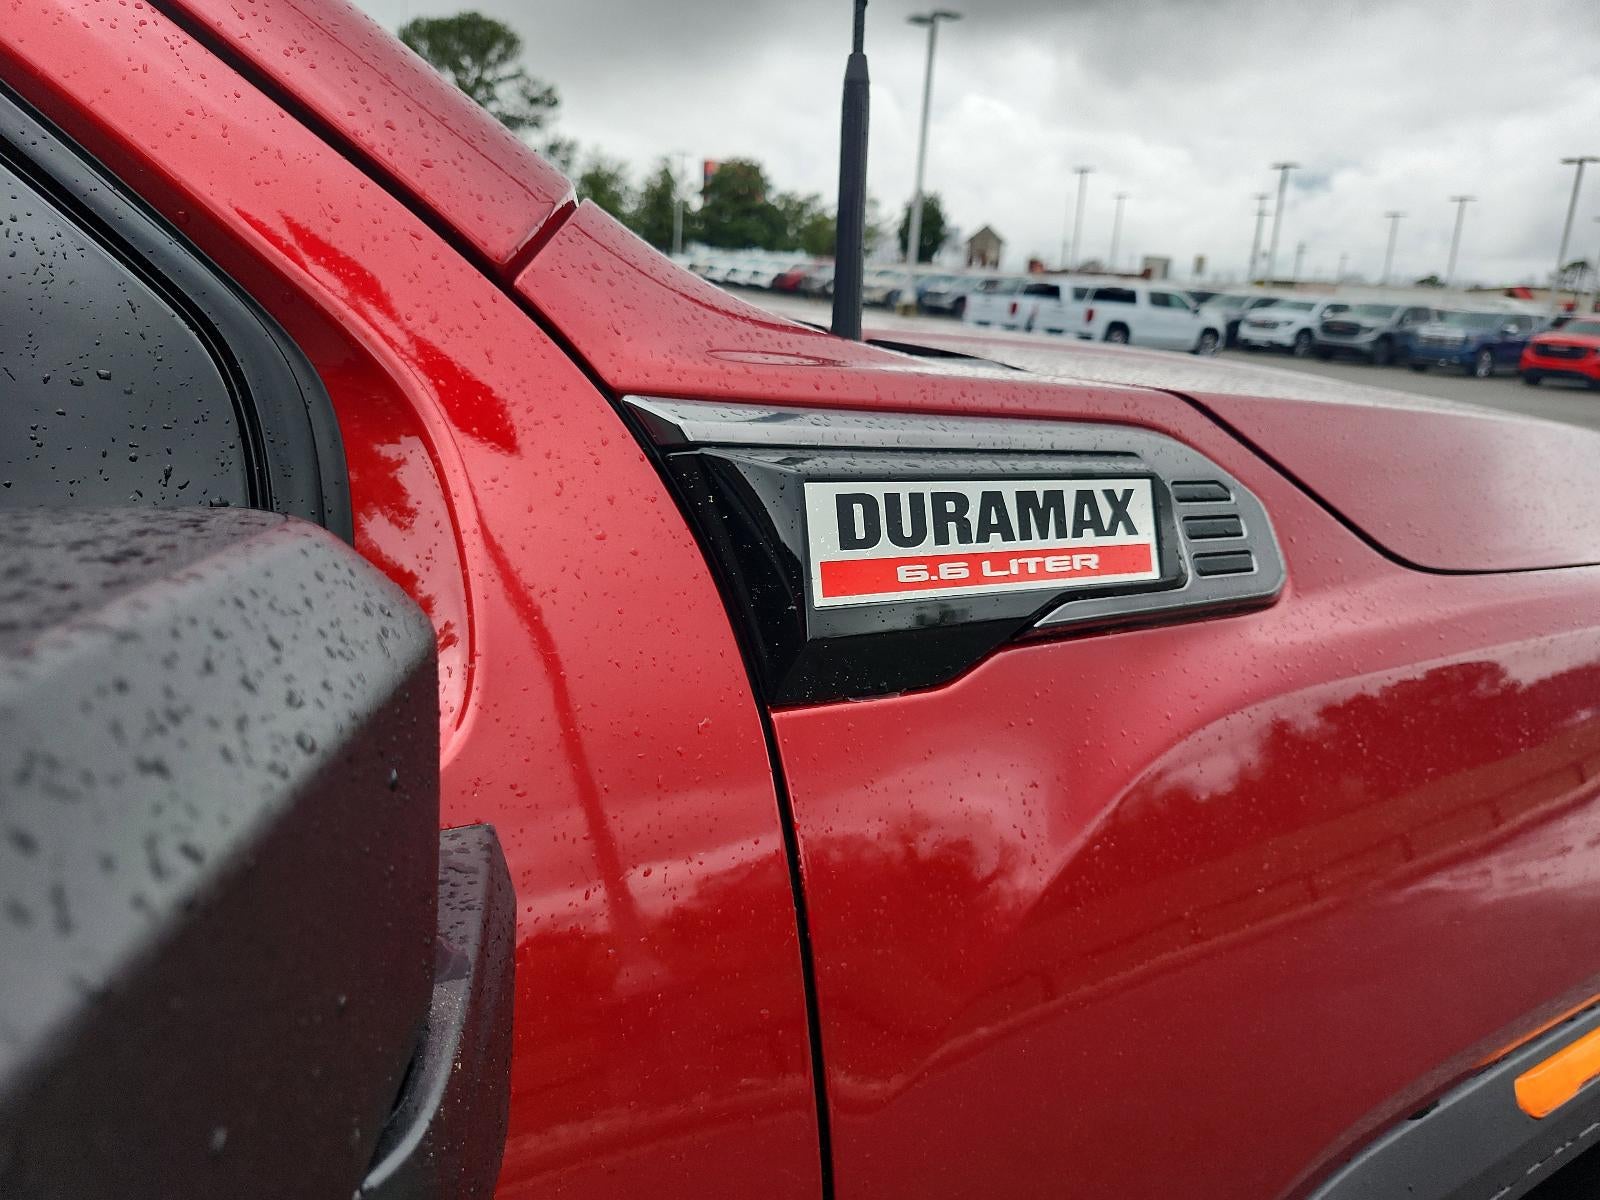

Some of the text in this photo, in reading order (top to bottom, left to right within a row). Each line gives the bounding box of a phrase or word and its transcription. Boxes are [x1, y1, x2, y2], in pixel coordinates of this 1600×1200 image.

[835, 489, 1138, 550] DURAMAX
[896, 554, 1100, 583] 6.6 LITER
